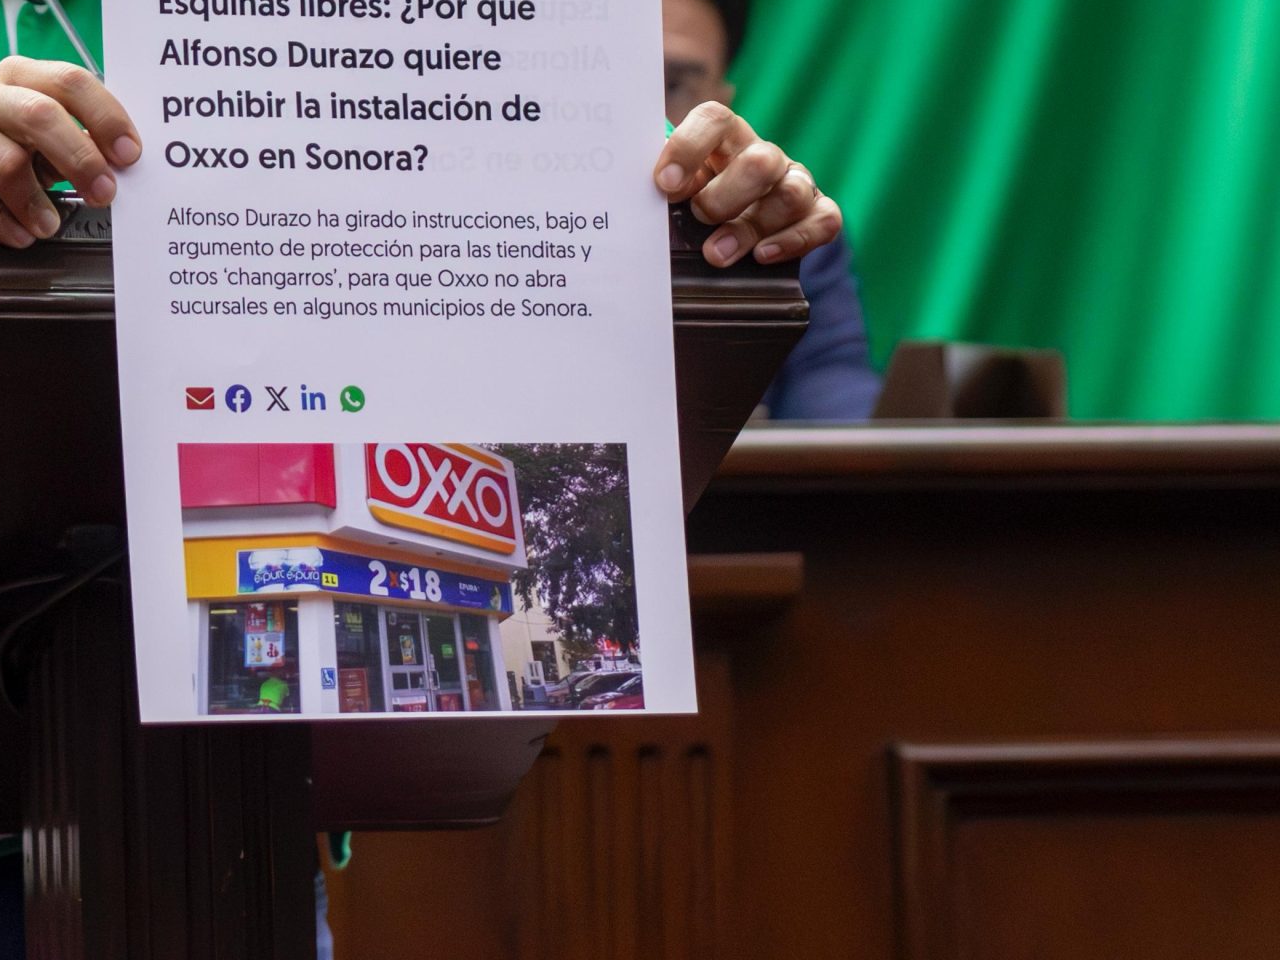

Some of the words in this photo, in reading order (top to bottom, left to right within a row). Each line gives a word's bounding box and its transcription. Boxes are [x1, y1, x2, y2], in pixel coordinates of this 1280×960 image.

[159, 38, 278, 68] Alfonso
[287, 41, 394, 70] Durazo
[403, 42, 502, 77] quiere
[162, 89, 286, 124] prohibir
[295, 91, 321, 119] la
[330, 91, 492, 121] instalación
[501, 94, 541, 122] de
[164, 140, 249, 169] Oxxo
[258, 148, 296, 169] en
[305, 142, 429, 172] Sonora?
[167, 207, 240, 227] Alfonso
[245, 208, 312, 228] Durazo
[317, 208, 340, 228] ha
[345, 209, 407, 232] girado
[412, 210, 540, 232] instrucciones,
[545, 211, 587, 234] bajo
[592, 211, 609, 230] el
[168, 240, 274, 260] argumento
[279, 238, 305, 257] de
[311, 239, 414, 261] protección
[419, 244, 461, 262] para
[467, 239, 492, 259] las
[496, 240, 576, 259] tienditas
[580, 245, 592, 263] y
[169, 268, 218, 286] otros
[348, 272, 389, 291] para
[395, 272, 433, 291] que
[437, 269, 489, 288] Oxxo
[495, 273, 519, 288] no
[525, 269, 567, 288] abra
[170, 296, 268, 315] sucursales
[273, 301, 297, 316] en
[303, 297, 378, 320] algunos
[383, 298, 485, 320] municipios
[490, 298, 516, 317] de
[521, 298, 592, 317] Sonora.
[300, 384, 326, 411] in
[375, 443, 508, 528] OXXO
